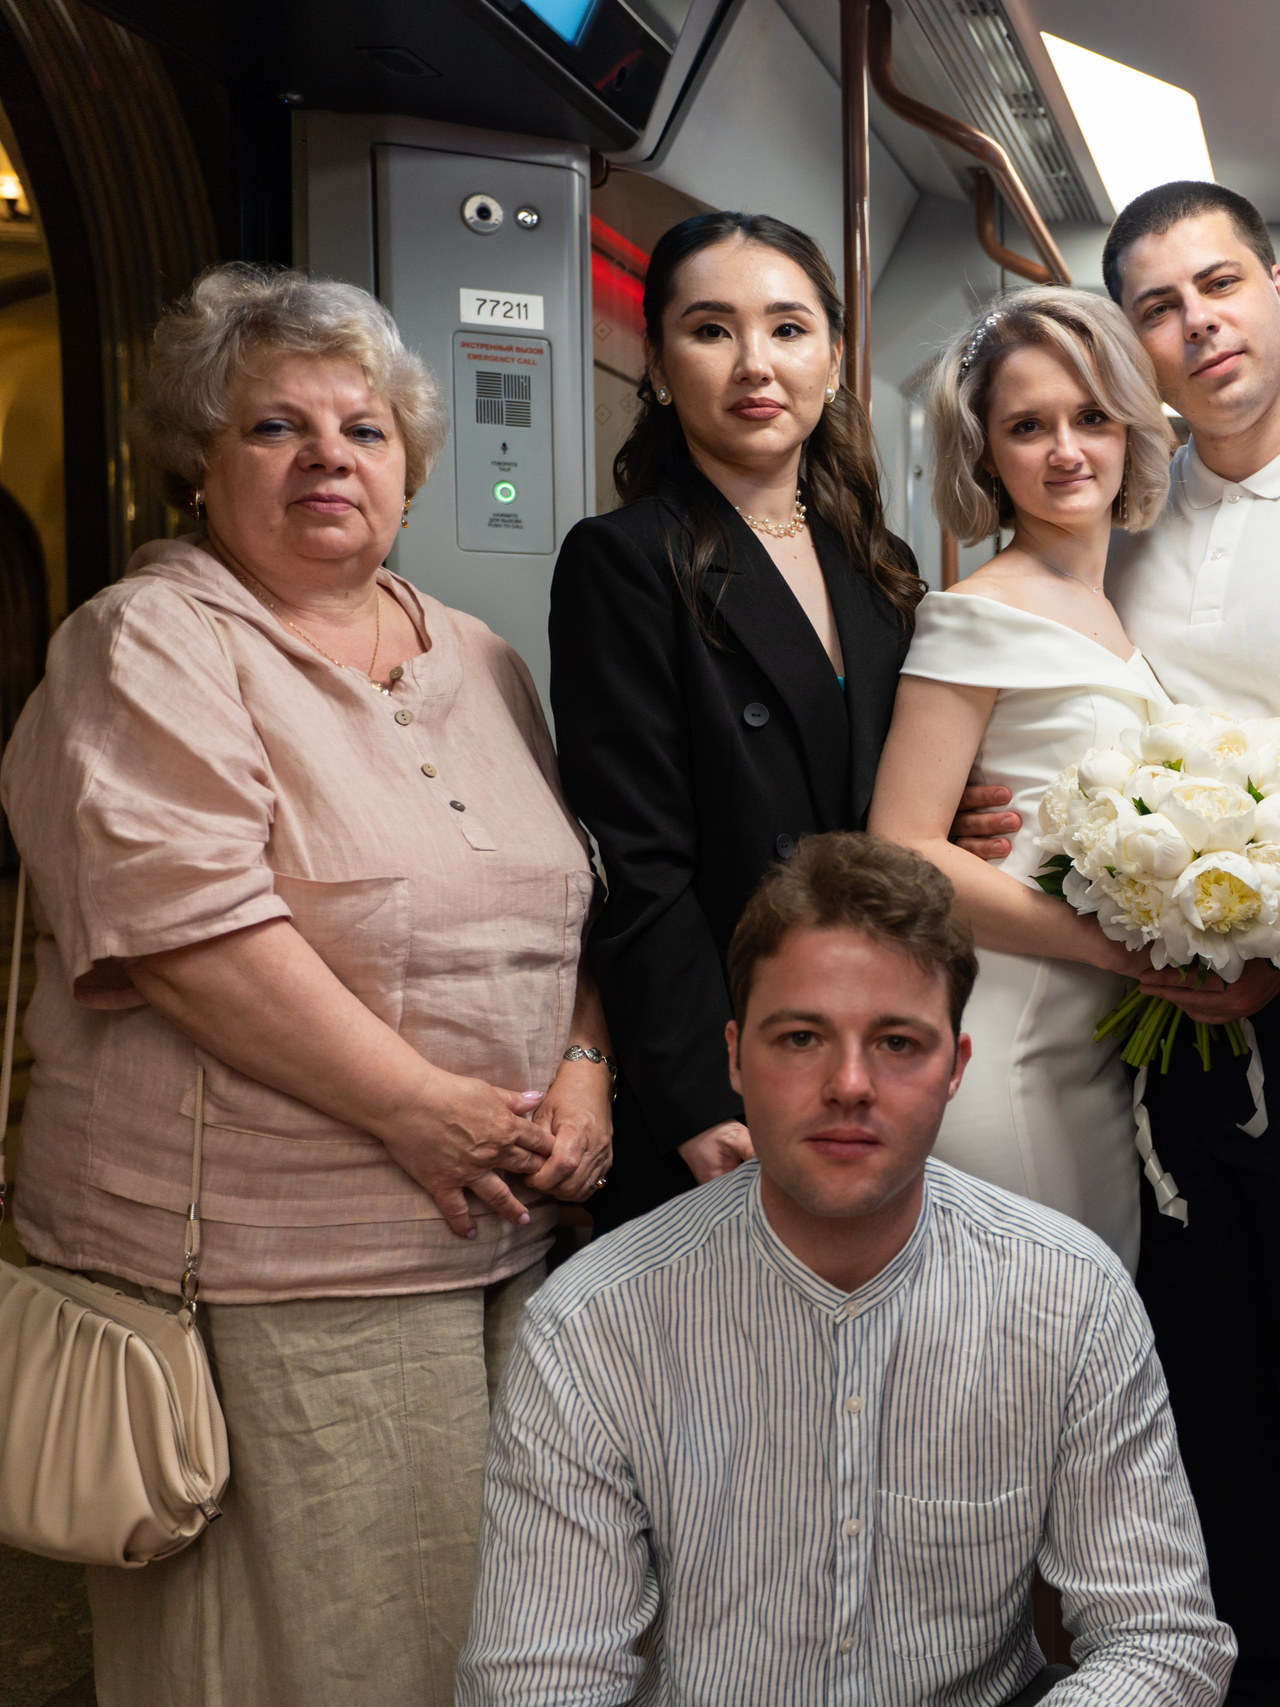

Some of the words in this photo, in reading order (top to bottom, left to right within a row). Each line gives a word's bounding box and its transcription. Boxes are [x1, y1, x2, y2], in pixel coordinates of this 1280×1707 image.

[476, 298, 528, 320] 77211
[460, 341, 514, 352] ЭКСТРЕННЫЙ
[515, 346, 544, 355] ВЫЗОВ
[467, 353, 516, 363] EMERGENCY
[517, 357, 537, 366] CALL
